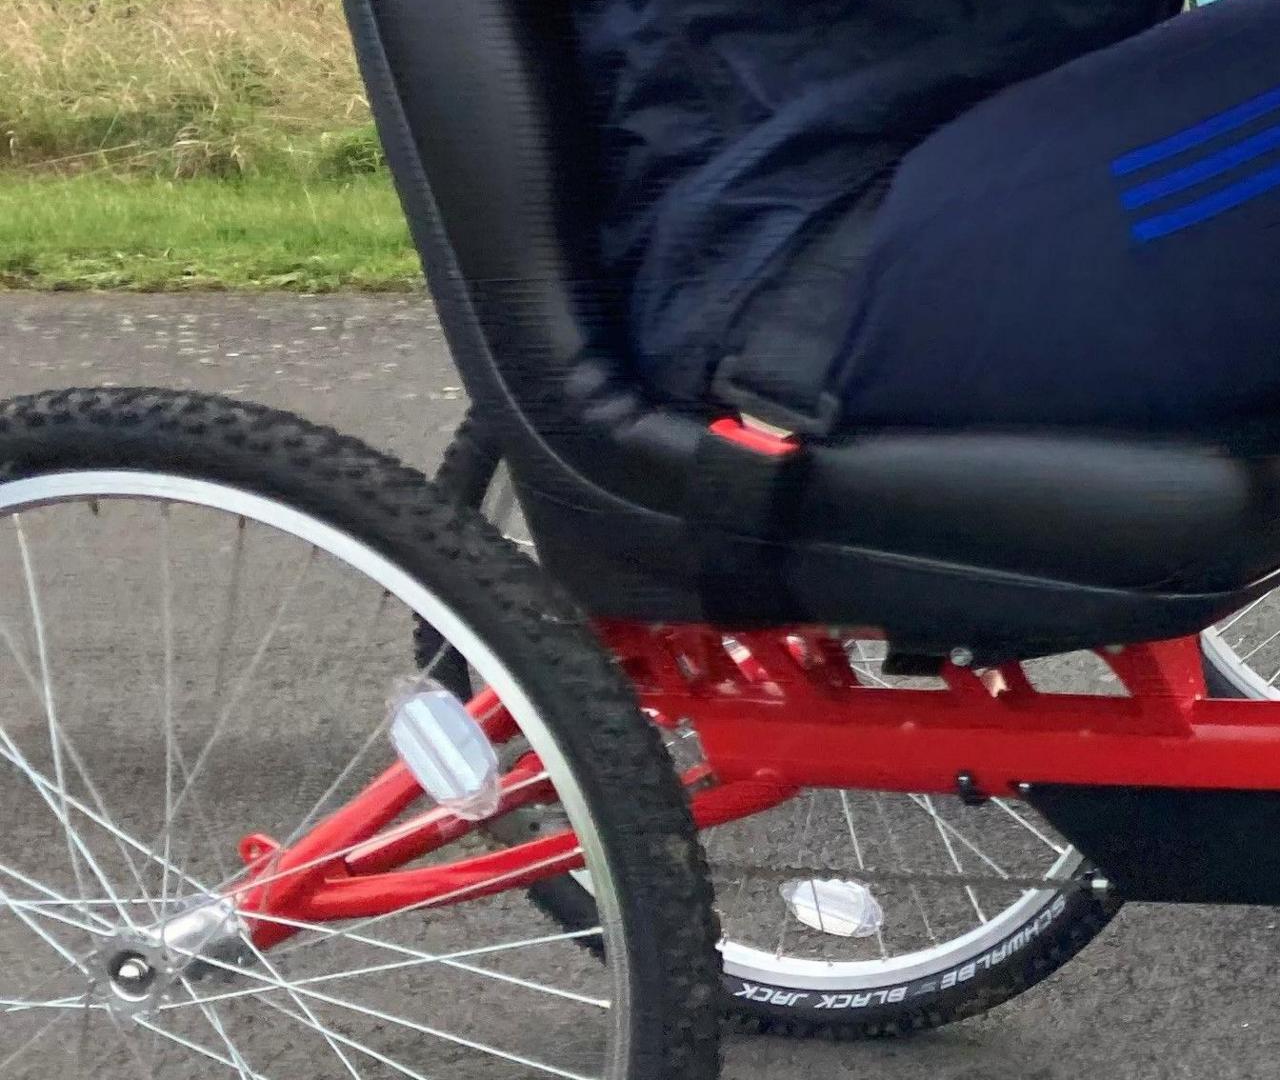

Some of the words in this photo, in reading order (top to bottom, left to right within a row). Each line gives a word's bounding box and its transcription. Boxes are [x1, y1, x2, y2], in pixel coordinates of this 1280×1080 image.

[939, 894, 1066, 990] SCHWALBE
[733, 982, 809, 1007] JACK
[814, 986, 908, 1009] BLACK
